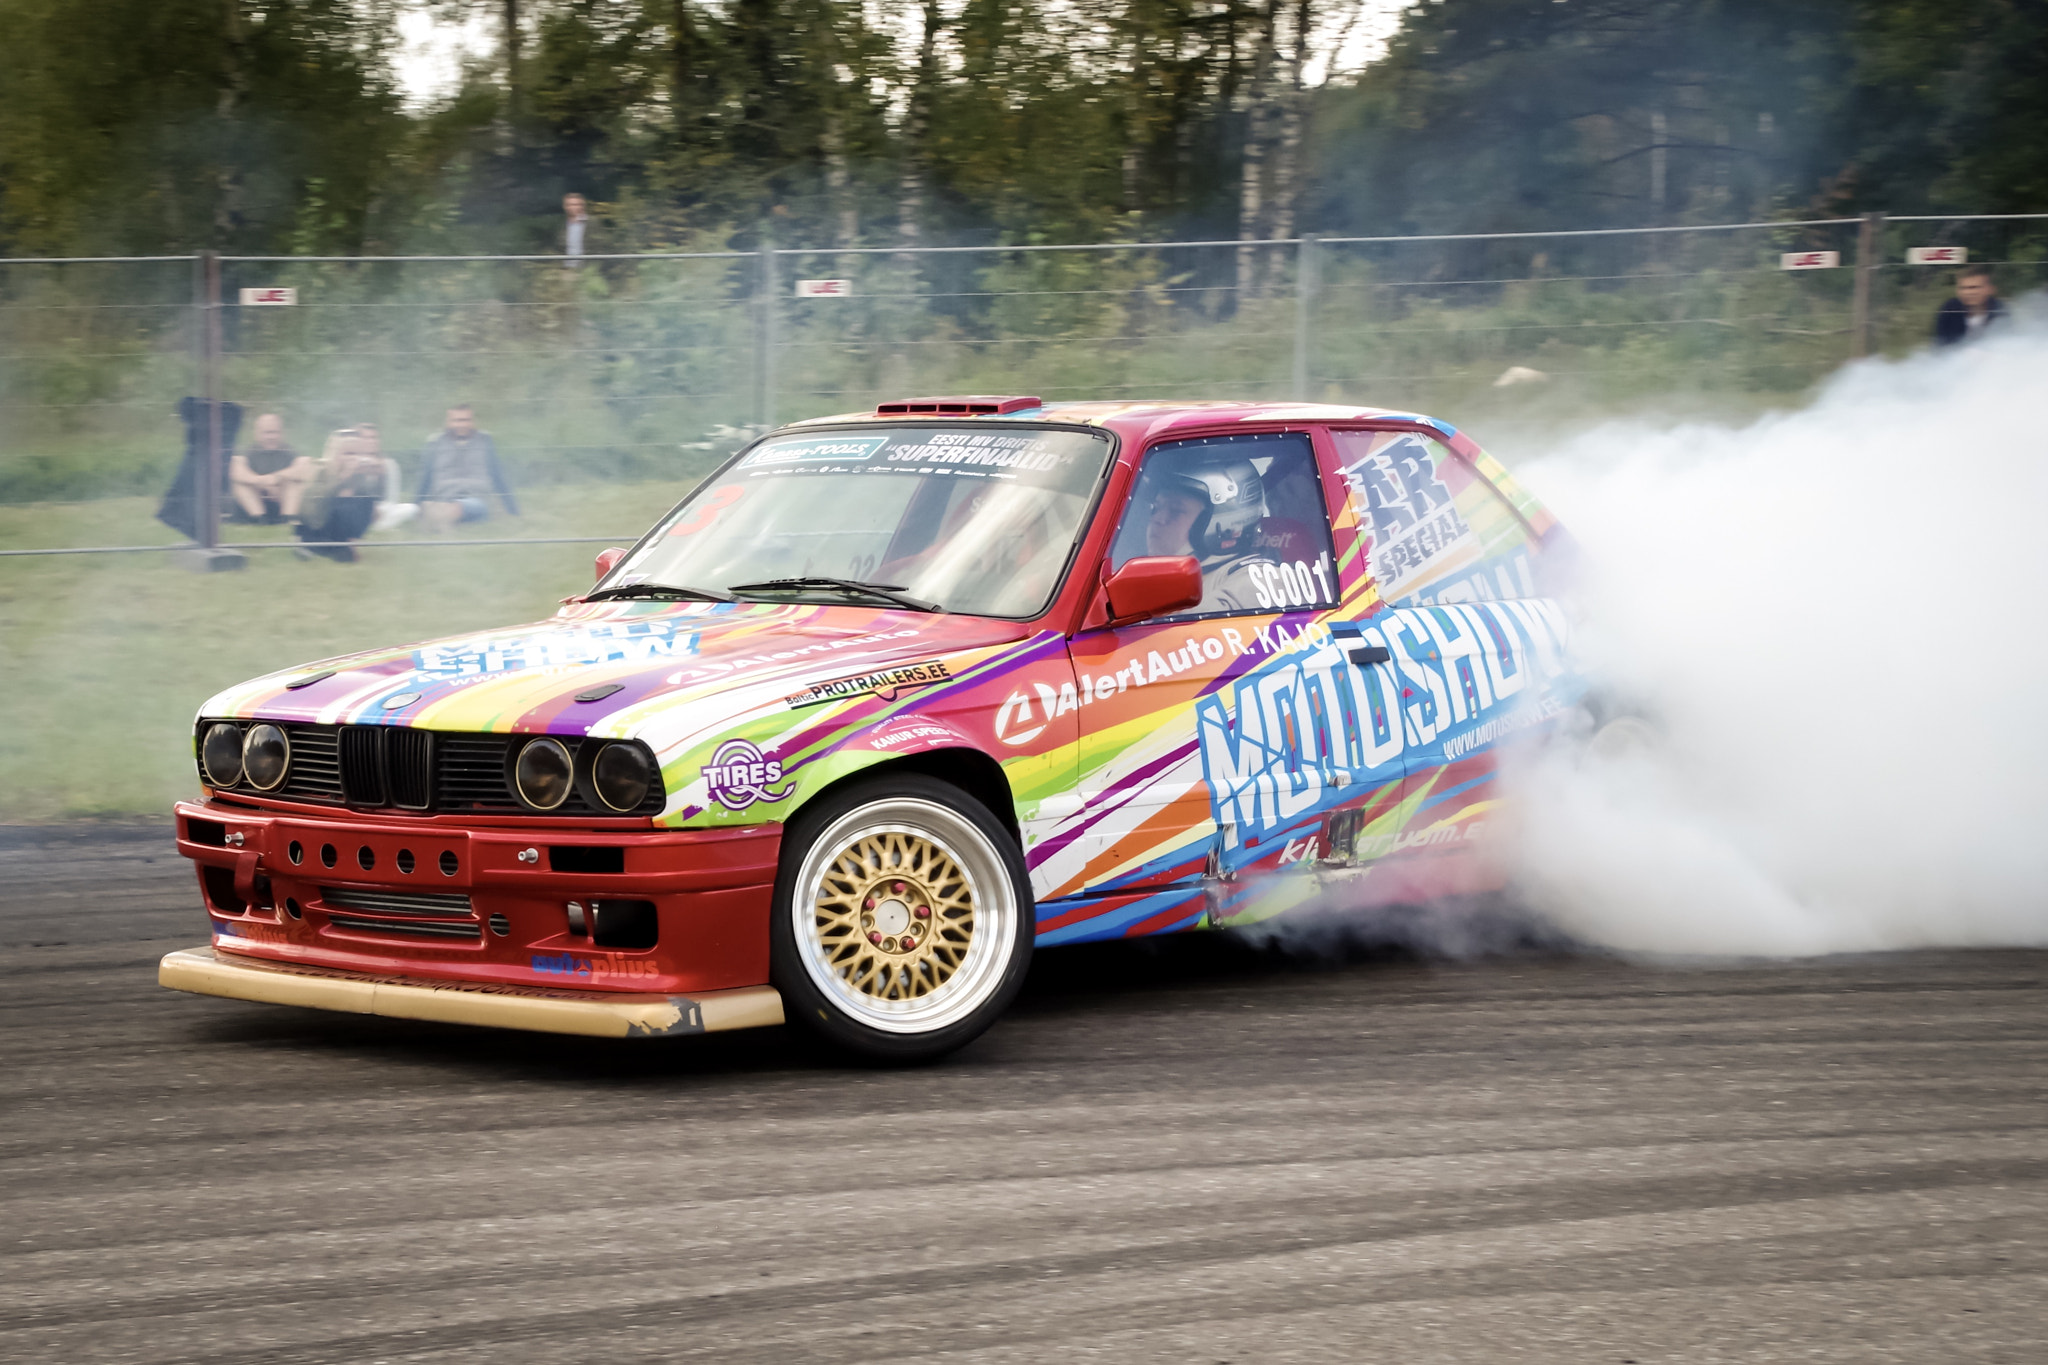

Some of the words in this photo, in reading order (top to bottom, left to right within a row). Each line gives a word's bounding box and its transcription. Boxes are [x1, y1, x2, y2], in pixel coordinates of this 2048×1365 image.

[928, 434, 971, 445] EESTI
[970, 435, 994, 446] MV
[1376, 507, 1468, 587] SPECIAL
[1221, 627, 1256, 656] R.
[1253, 622, 1328, 653] KAJO
[1055, 637, 1224, 718] AlertAuto
[870, 730, 915, 749] KAHUR
[703, 761, 782, 789] TIRES
[531, 951, 660, 985] autoplius
